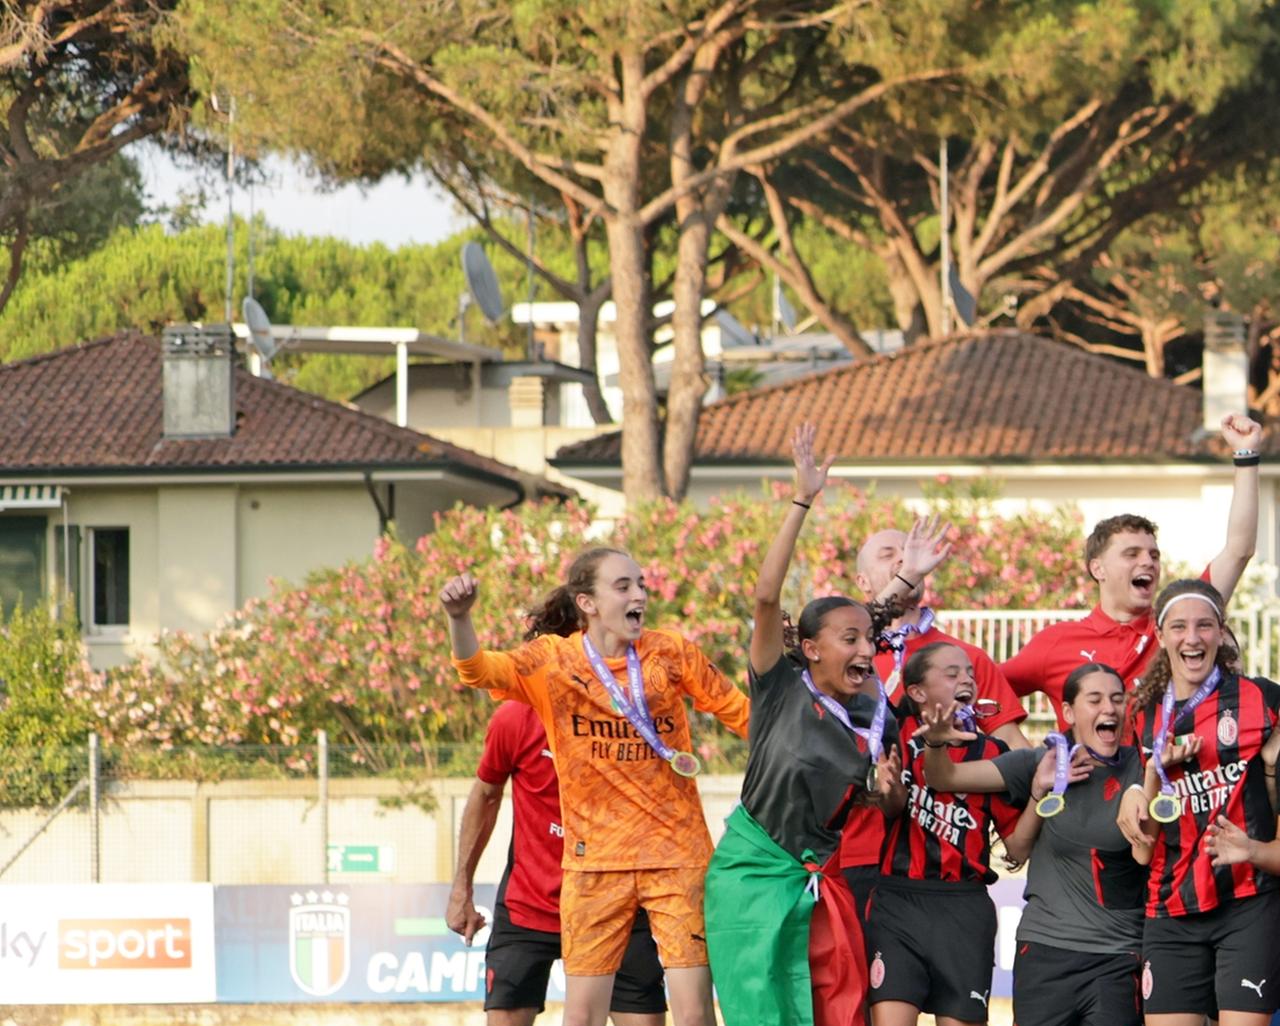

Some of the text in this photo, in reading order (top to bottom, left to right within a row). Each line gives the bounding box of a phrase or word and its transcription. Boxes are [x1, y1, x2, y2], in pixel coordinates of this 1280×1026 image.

[572, 714, 675, 739] Emires
[592, 741, 613, 759] FLY
[0, 922, 184, 968] ky sport
